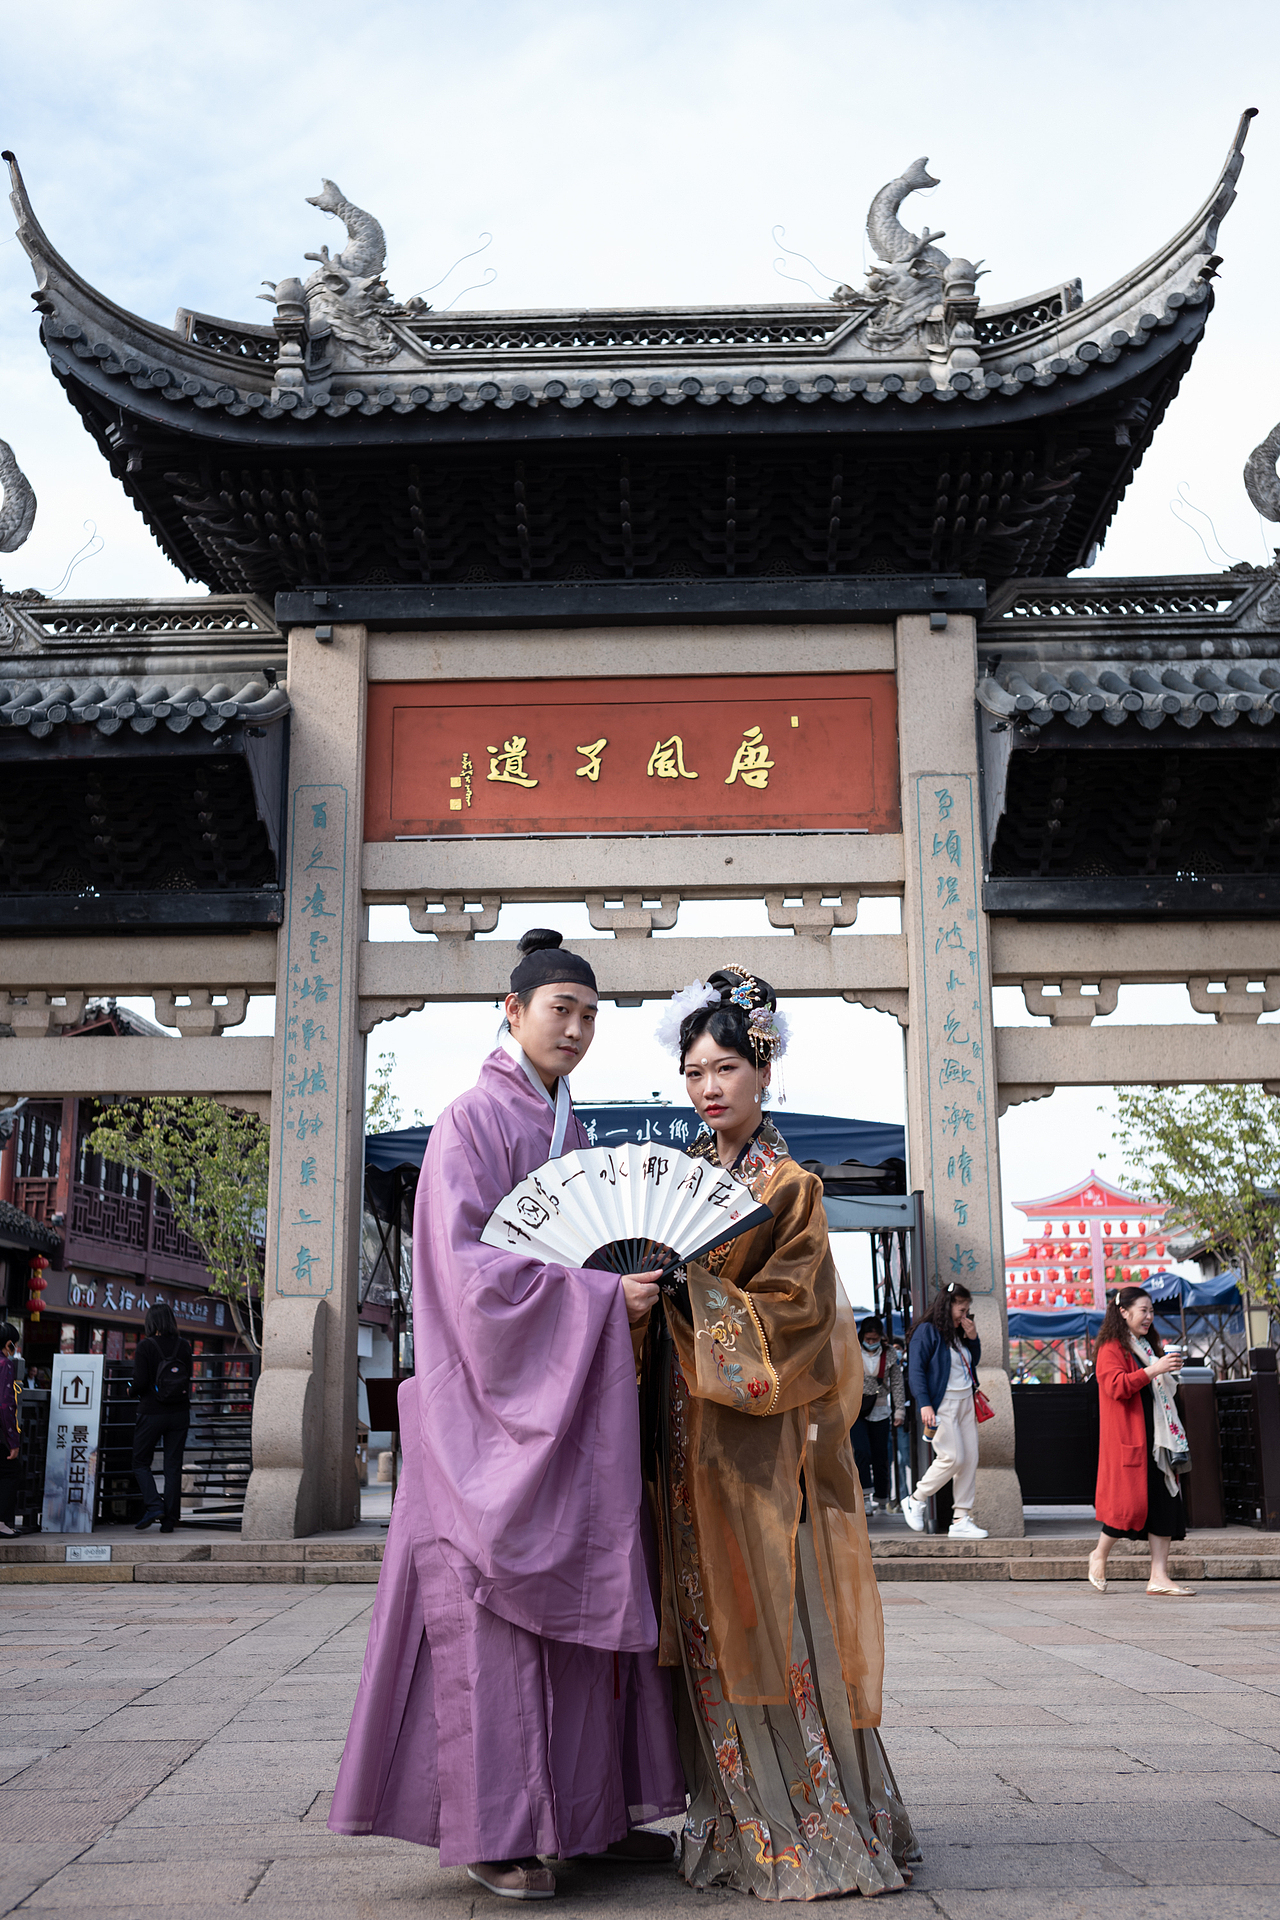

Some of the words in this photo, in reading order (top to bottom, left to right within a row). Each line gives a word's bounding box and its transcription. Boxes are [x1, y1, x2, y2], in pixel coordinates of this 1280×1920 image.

[56, 1424, 68, 1449] Exit
[67, 1425, 89, 1504] 景区出口
